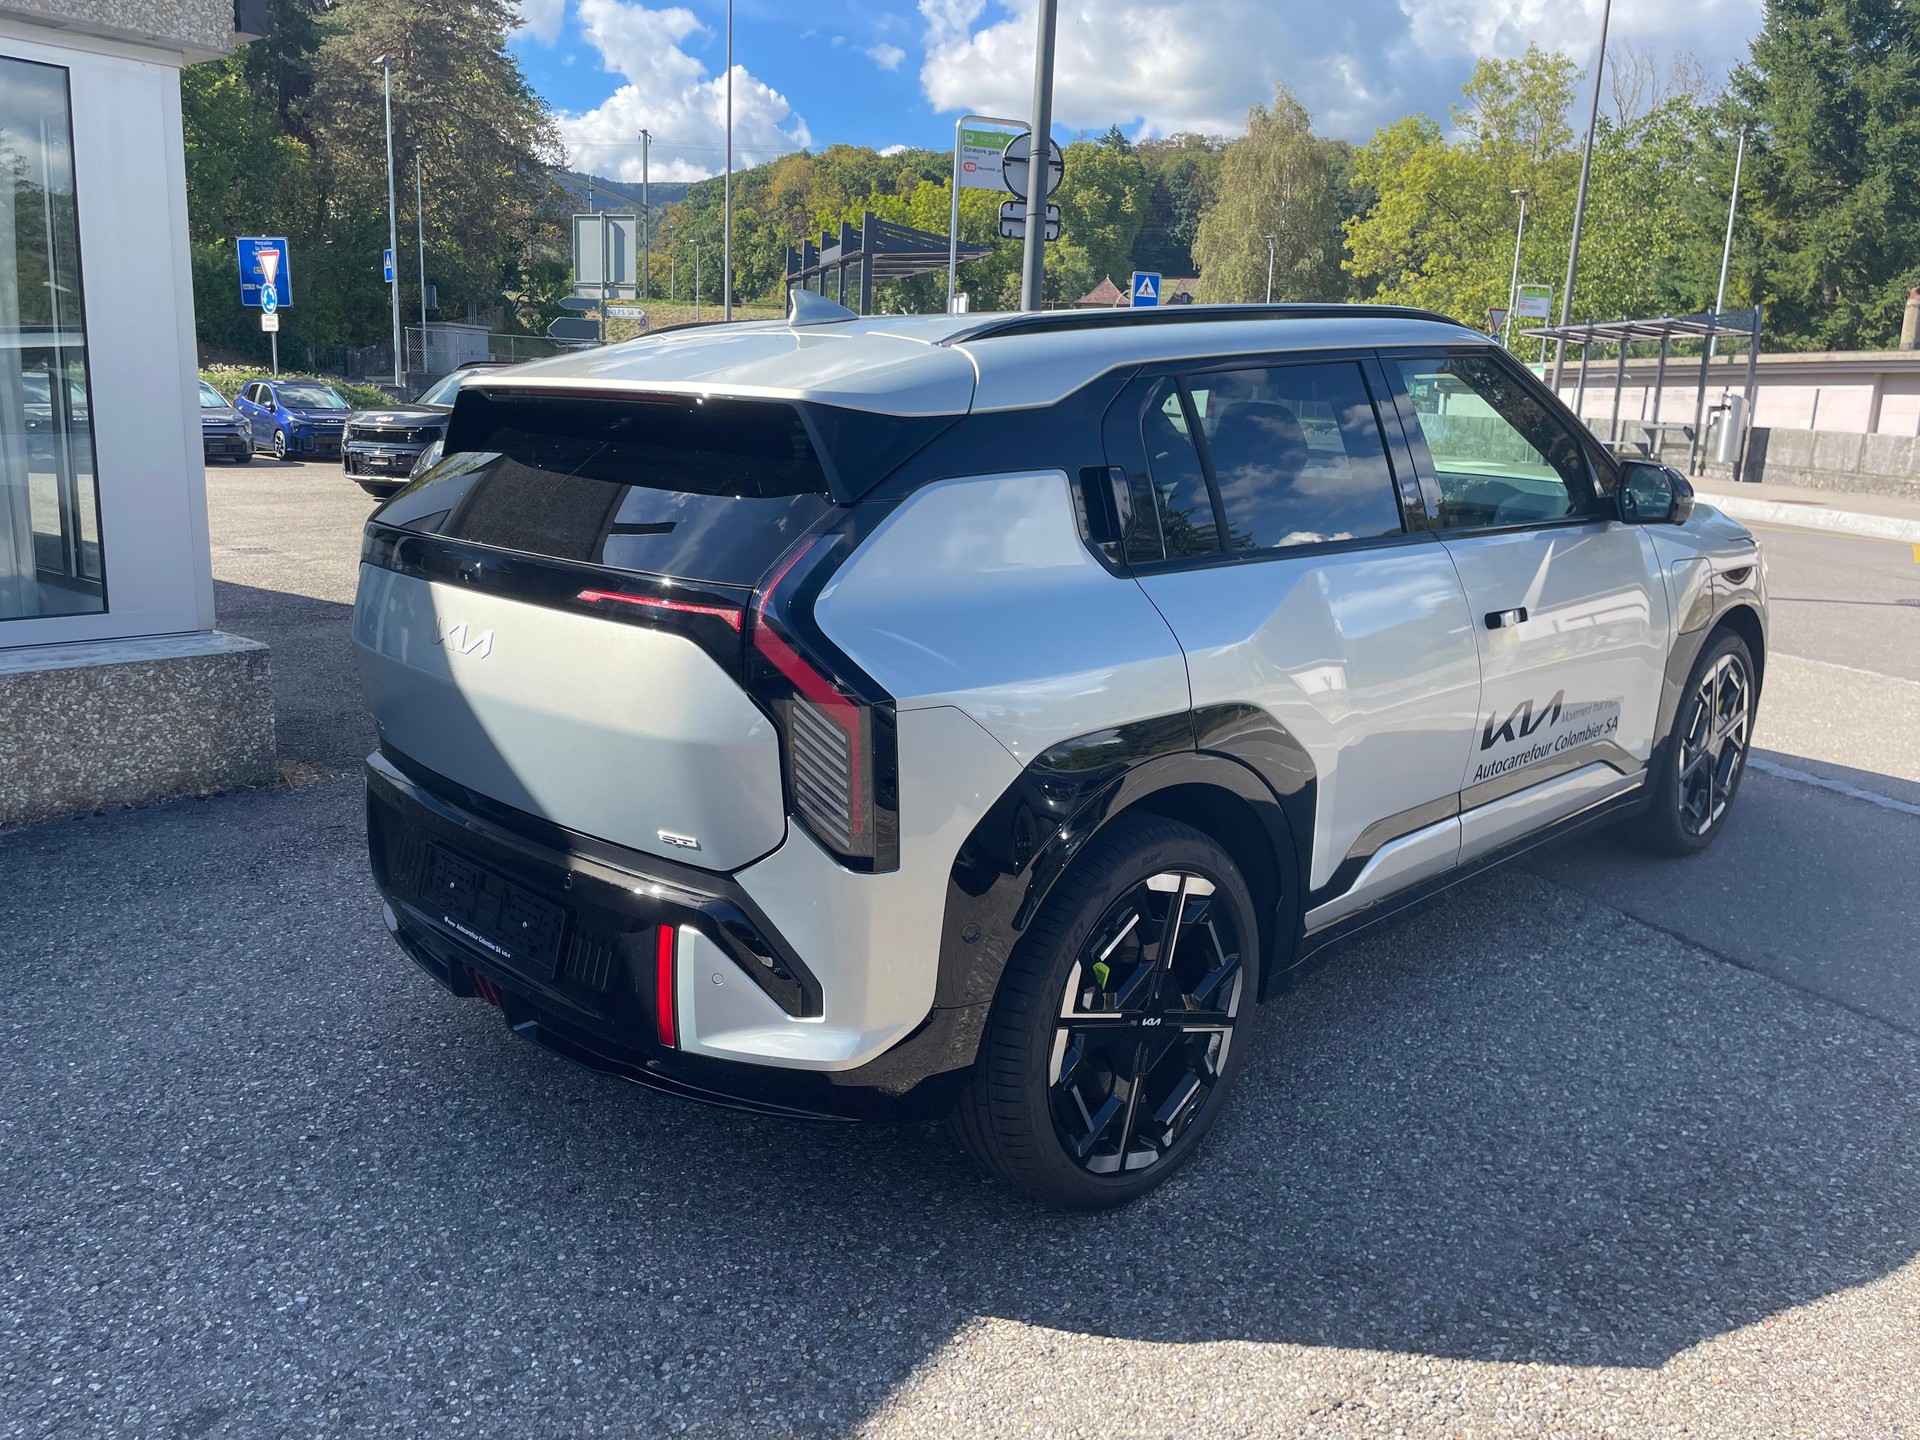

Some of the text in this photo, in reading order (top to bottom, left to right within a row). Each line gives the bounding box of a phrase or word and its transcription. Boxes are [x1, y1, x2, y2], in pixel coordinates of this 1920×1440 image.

[963, 146, 987, 155] Giratoire
[965, 163, 976, 171] 120
[1480, 689, 1565, 751] KIA
[1473, 715, 1619, 783] Autocarrefour Colombier SA
[1141, 1018, 1162, 1026] KIA
